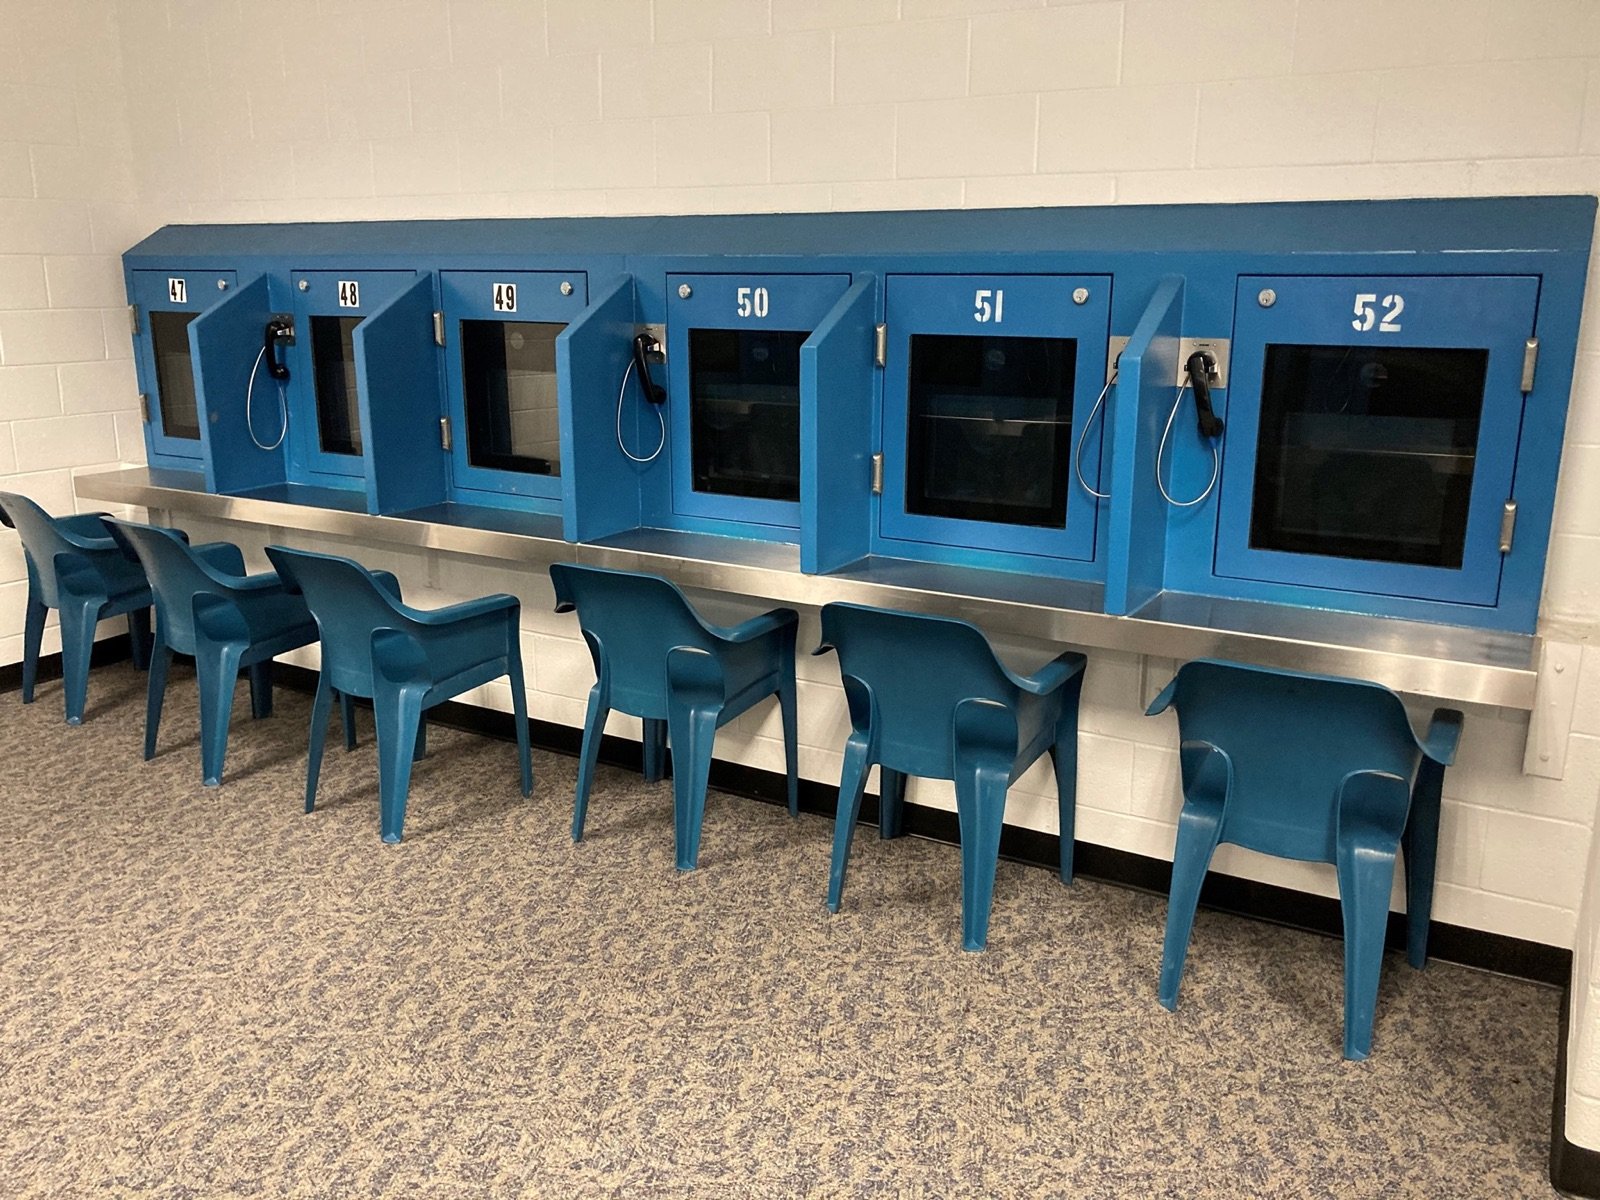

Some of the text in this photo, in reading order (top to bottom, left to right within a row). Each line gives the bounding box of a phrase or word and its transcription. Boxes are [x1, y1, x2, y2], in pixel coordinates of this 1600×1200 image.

[171, 280, 184, 301] 47
[340, 283, 357, 305] 48
[495, 285, 515, 310] 49
[737, 287, 769, 318] 50
[974, 289, 1003, 323] 51
[1351, 294, 1405, 332] 52
